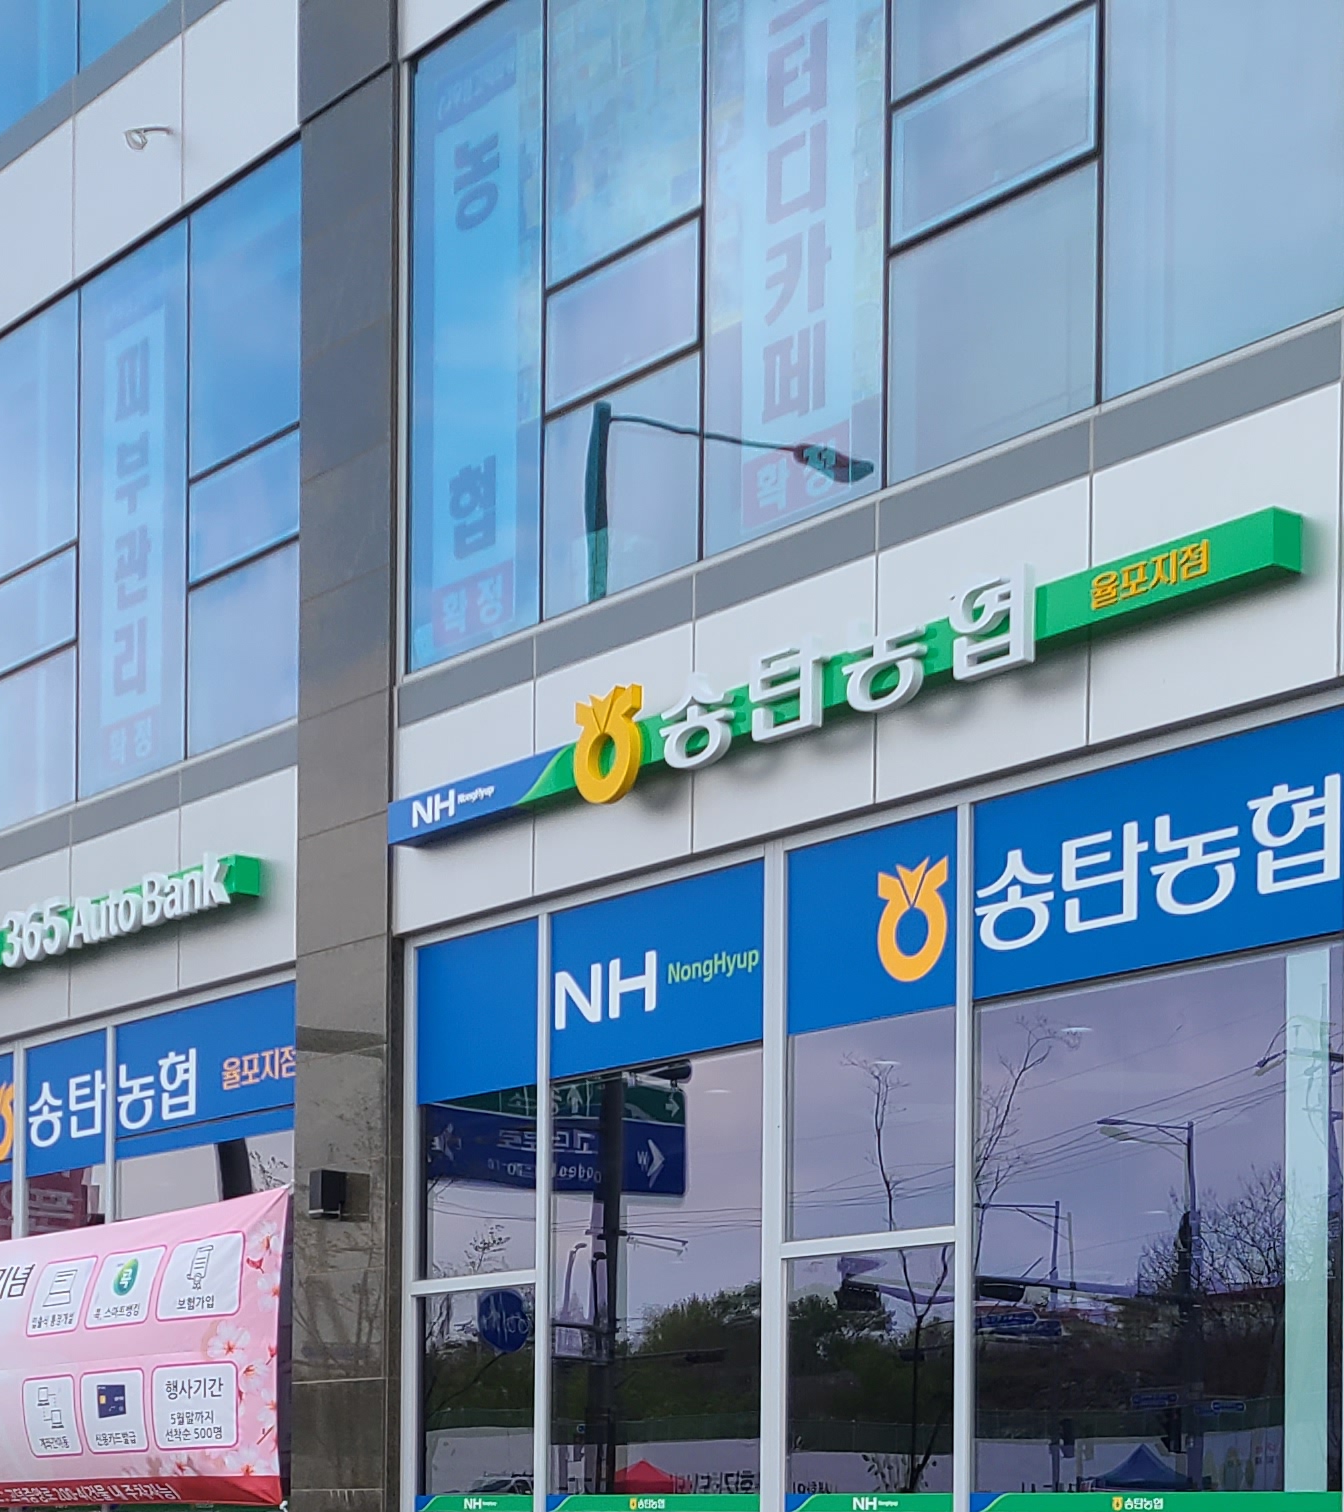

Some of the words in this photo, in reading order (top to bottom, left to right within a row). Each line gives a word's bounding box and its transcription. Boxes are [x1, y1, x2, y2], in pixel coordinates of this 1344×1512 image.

[412, 788, 456, 829] NH
[659, 562, 1037, 770] 송탄농협
[1090, 538, 1209, 613] 율포지점
[555, 949, 656, 1031] NH
[667, 948, 759, 985] NongHyup
[973, 772, 1343, 952] 송탄농협
[1, 901, 69, 969] 365
[28, 1047, 197, 1149] 송탄농협
[221, 1045, 297, 1091] 율포지점
[175, 1294, 215, 1311] 보험가입
[164, 1377, 224, 1401] 행사기간
[169, 1409, 215, 1426] 5월말까지
[164, 1427, 192, 1442] 선착순
[193, 1425, 223, 1442] 500명
[463, 1498, 482, 1510] NH
[852, 1497, 877, 1511] NH
[1124, 1497, 1164, 1511] 송탄농협
